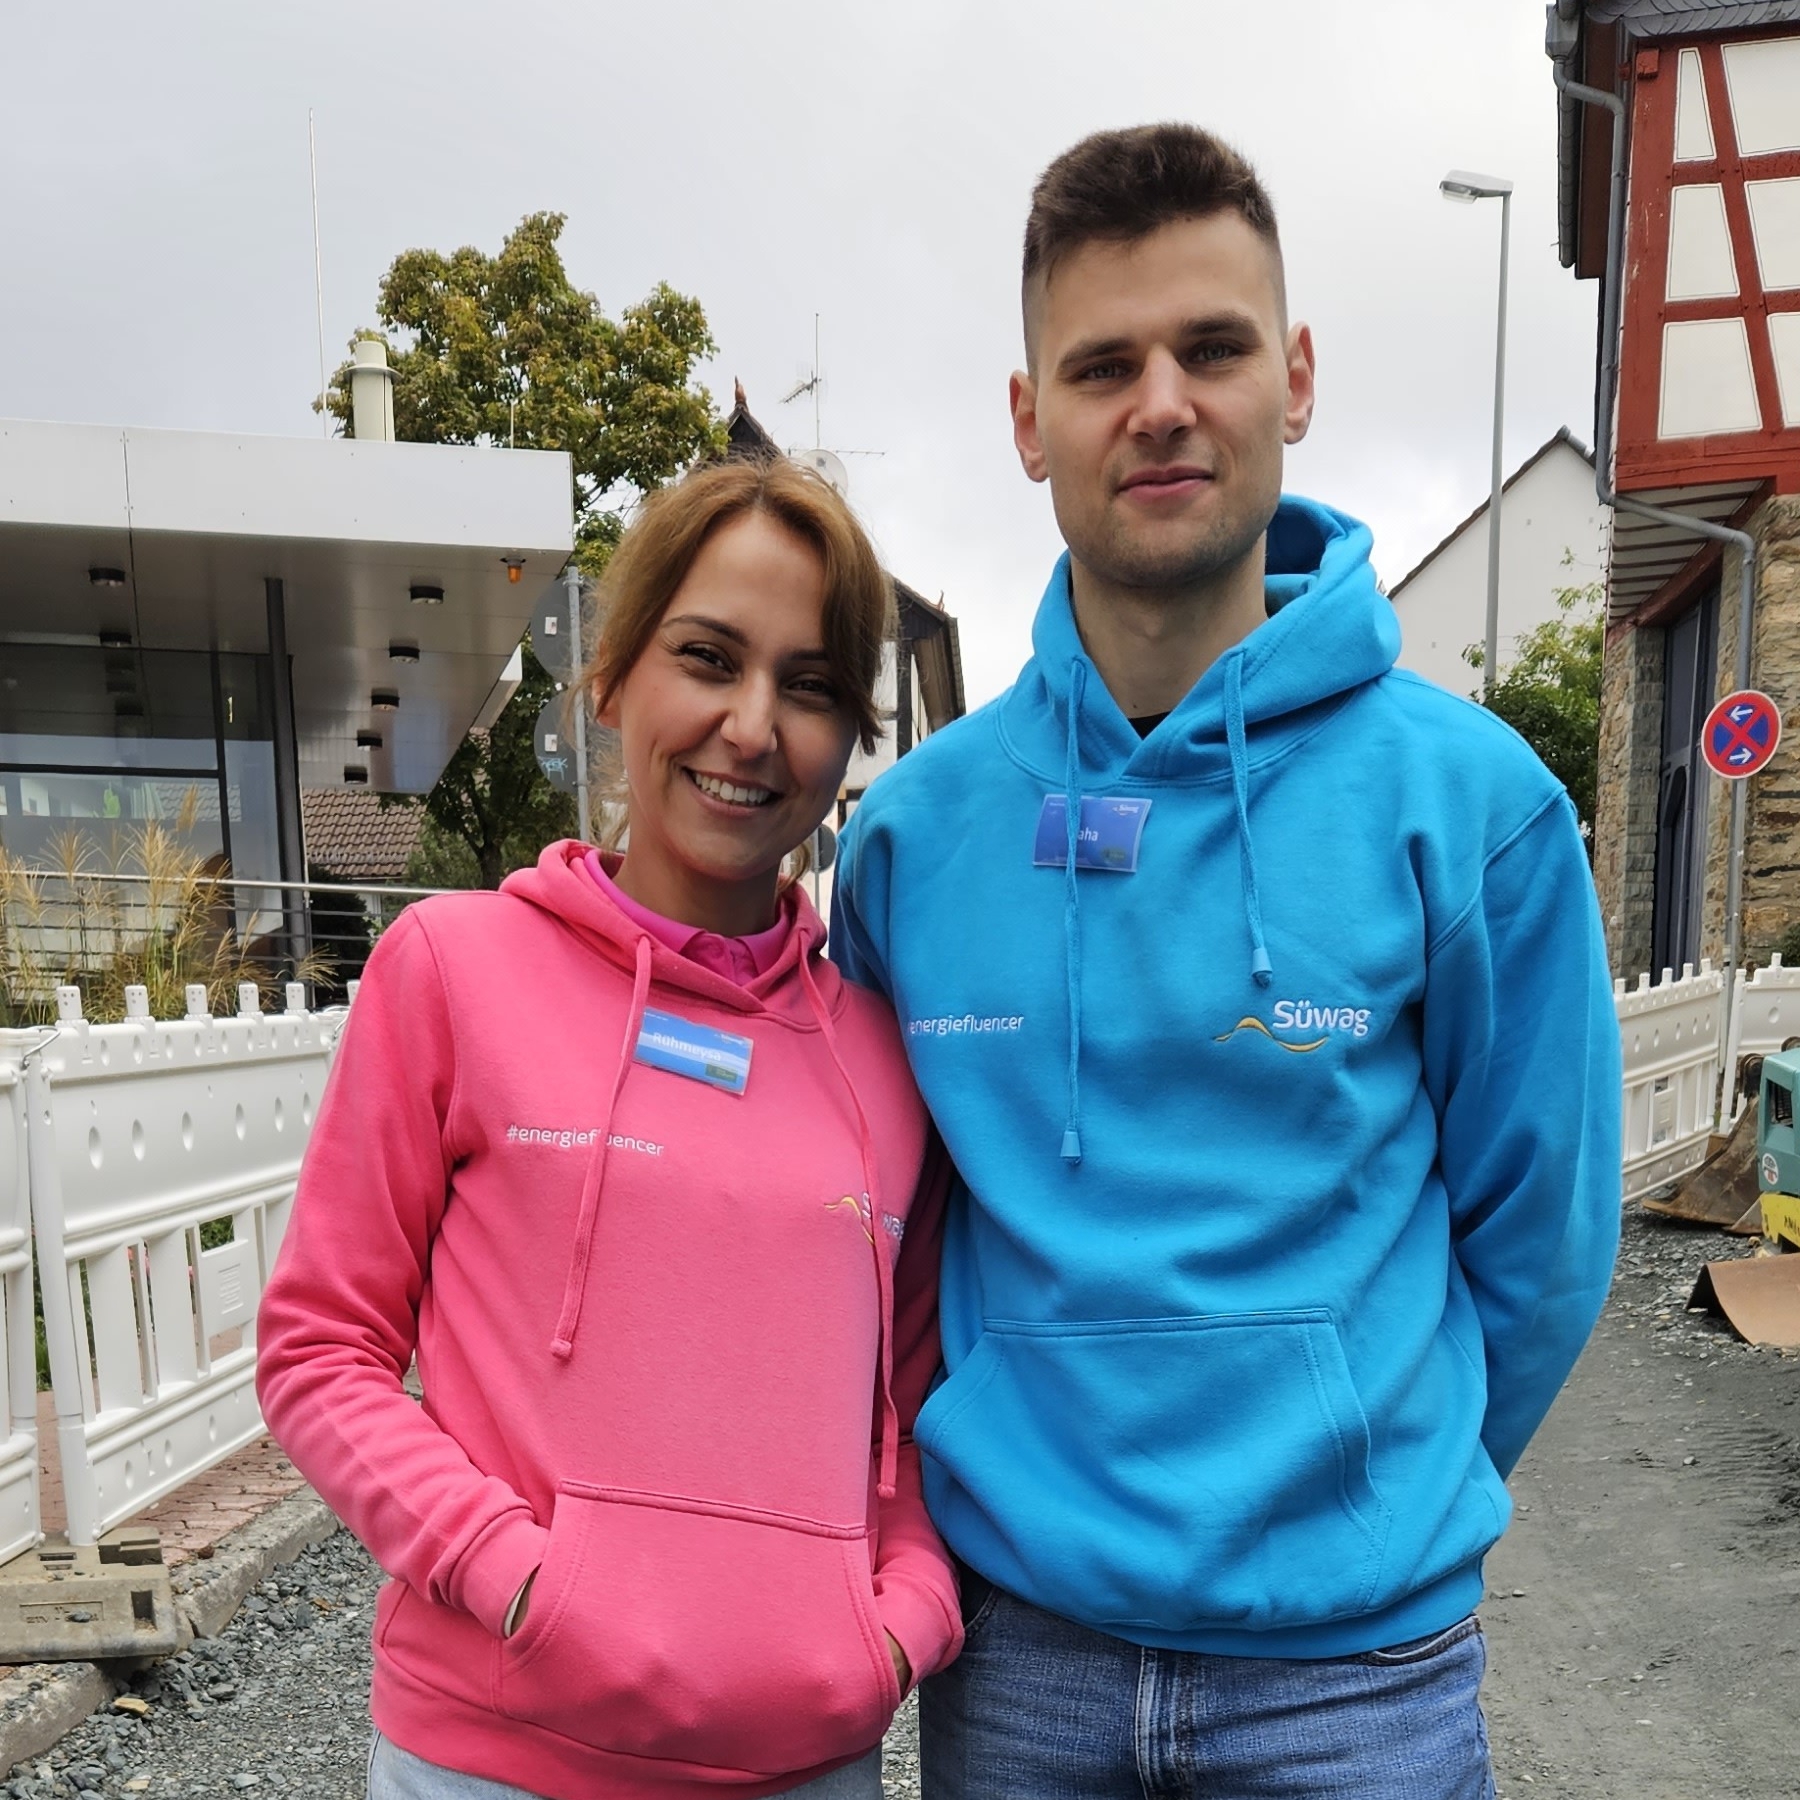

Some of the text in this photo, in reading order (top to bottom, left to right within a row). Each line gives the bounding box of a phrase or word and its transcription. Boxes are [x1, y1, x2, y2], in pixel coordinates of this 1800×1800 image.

[1078, 827, 1099, 842] aha
[909, 1014, 1025, 1036] energiefluencer
[1272, 999, 1372, 1038] Süwag
[507, 1124, 665, 1156] #energiefuencer
